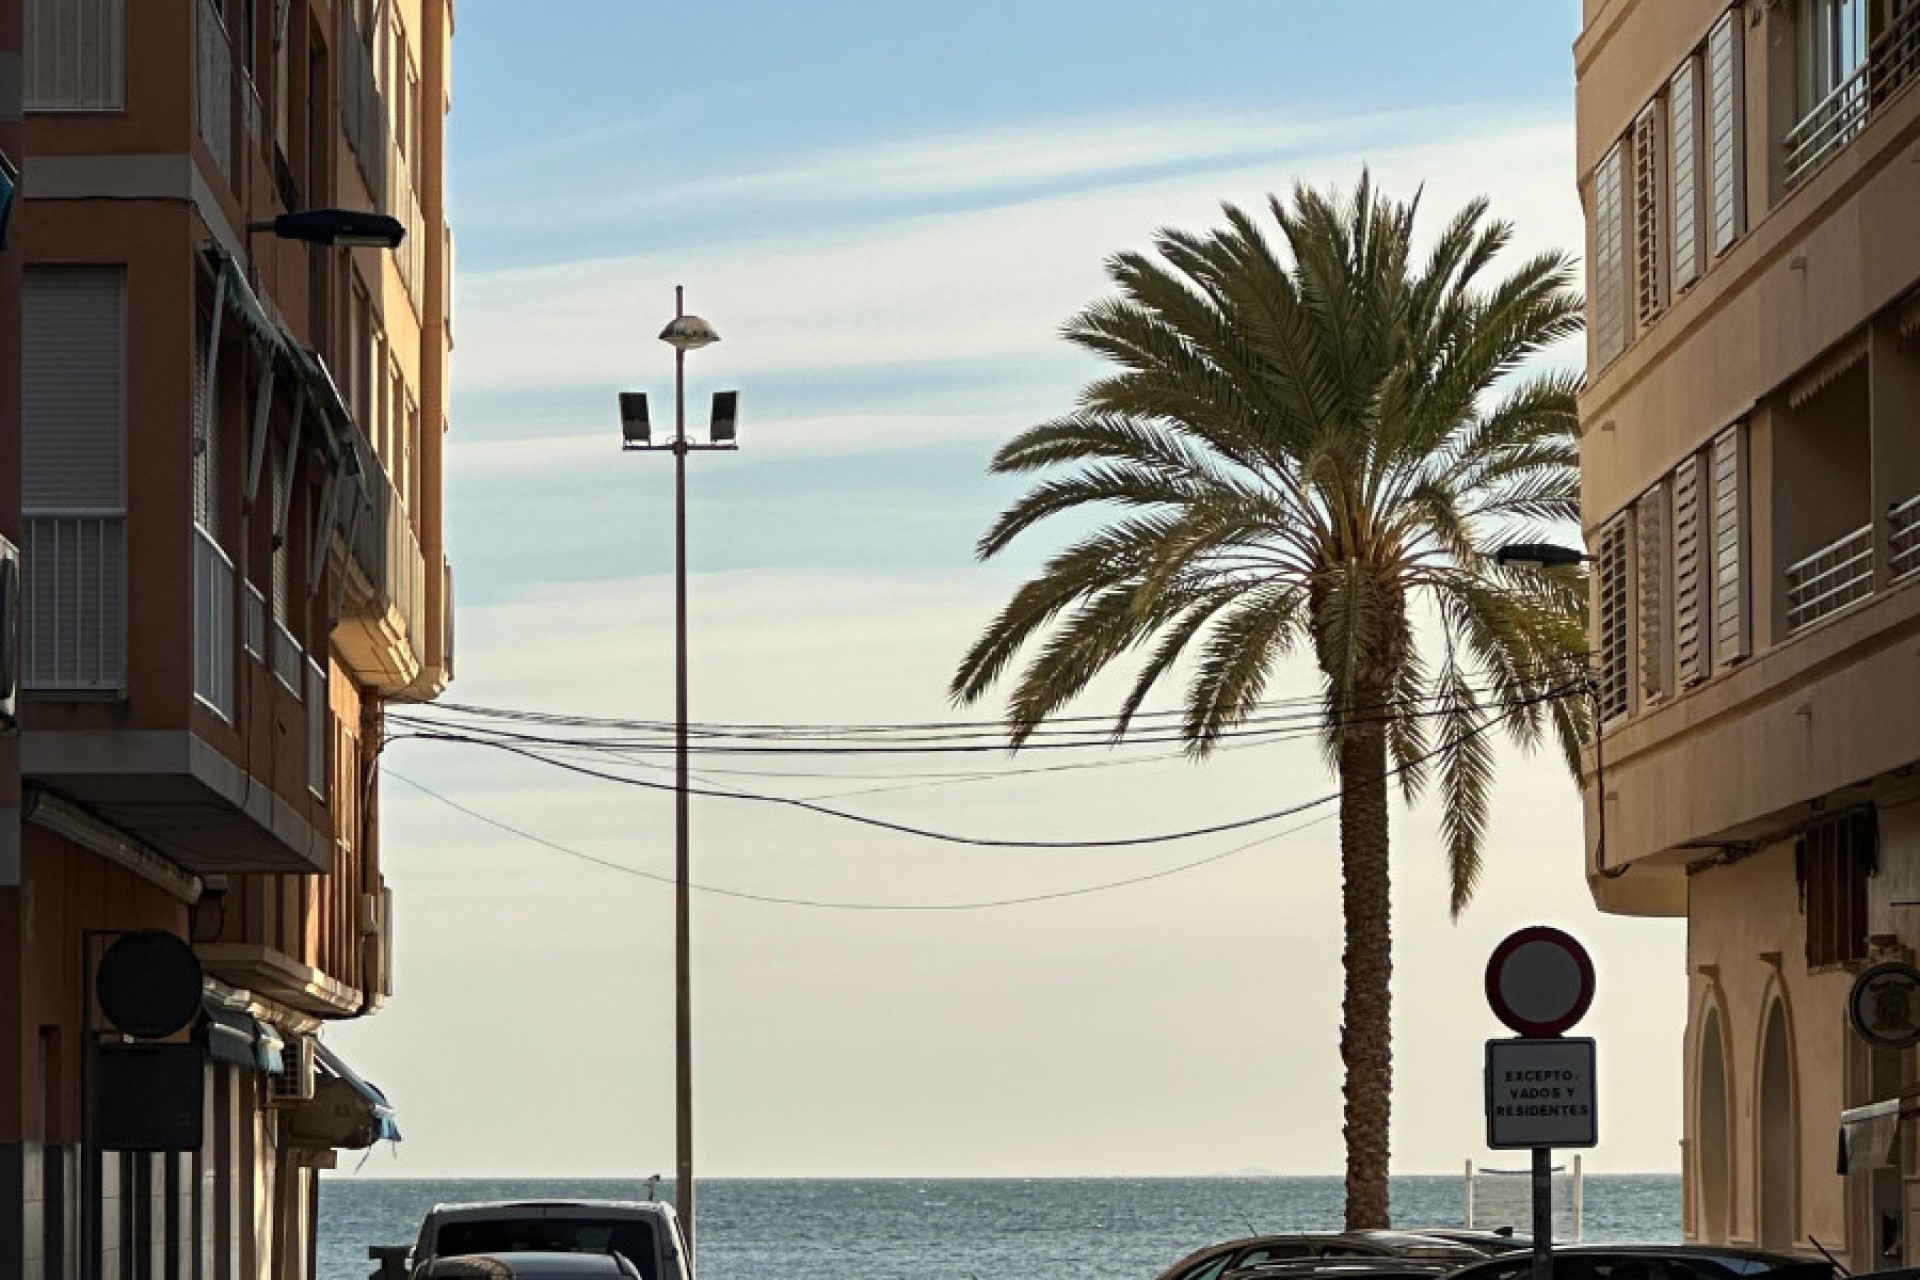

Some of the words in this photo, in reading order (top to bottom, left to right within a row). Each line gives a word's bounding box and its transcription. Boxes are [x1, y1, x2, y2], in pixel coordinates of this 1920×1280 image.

[1510, 1088, 1561, 1099] VADOS
[1566, 1087, 1575, 1099] Y
[1496, 1104, 1588, 1116] RESIDENTES
